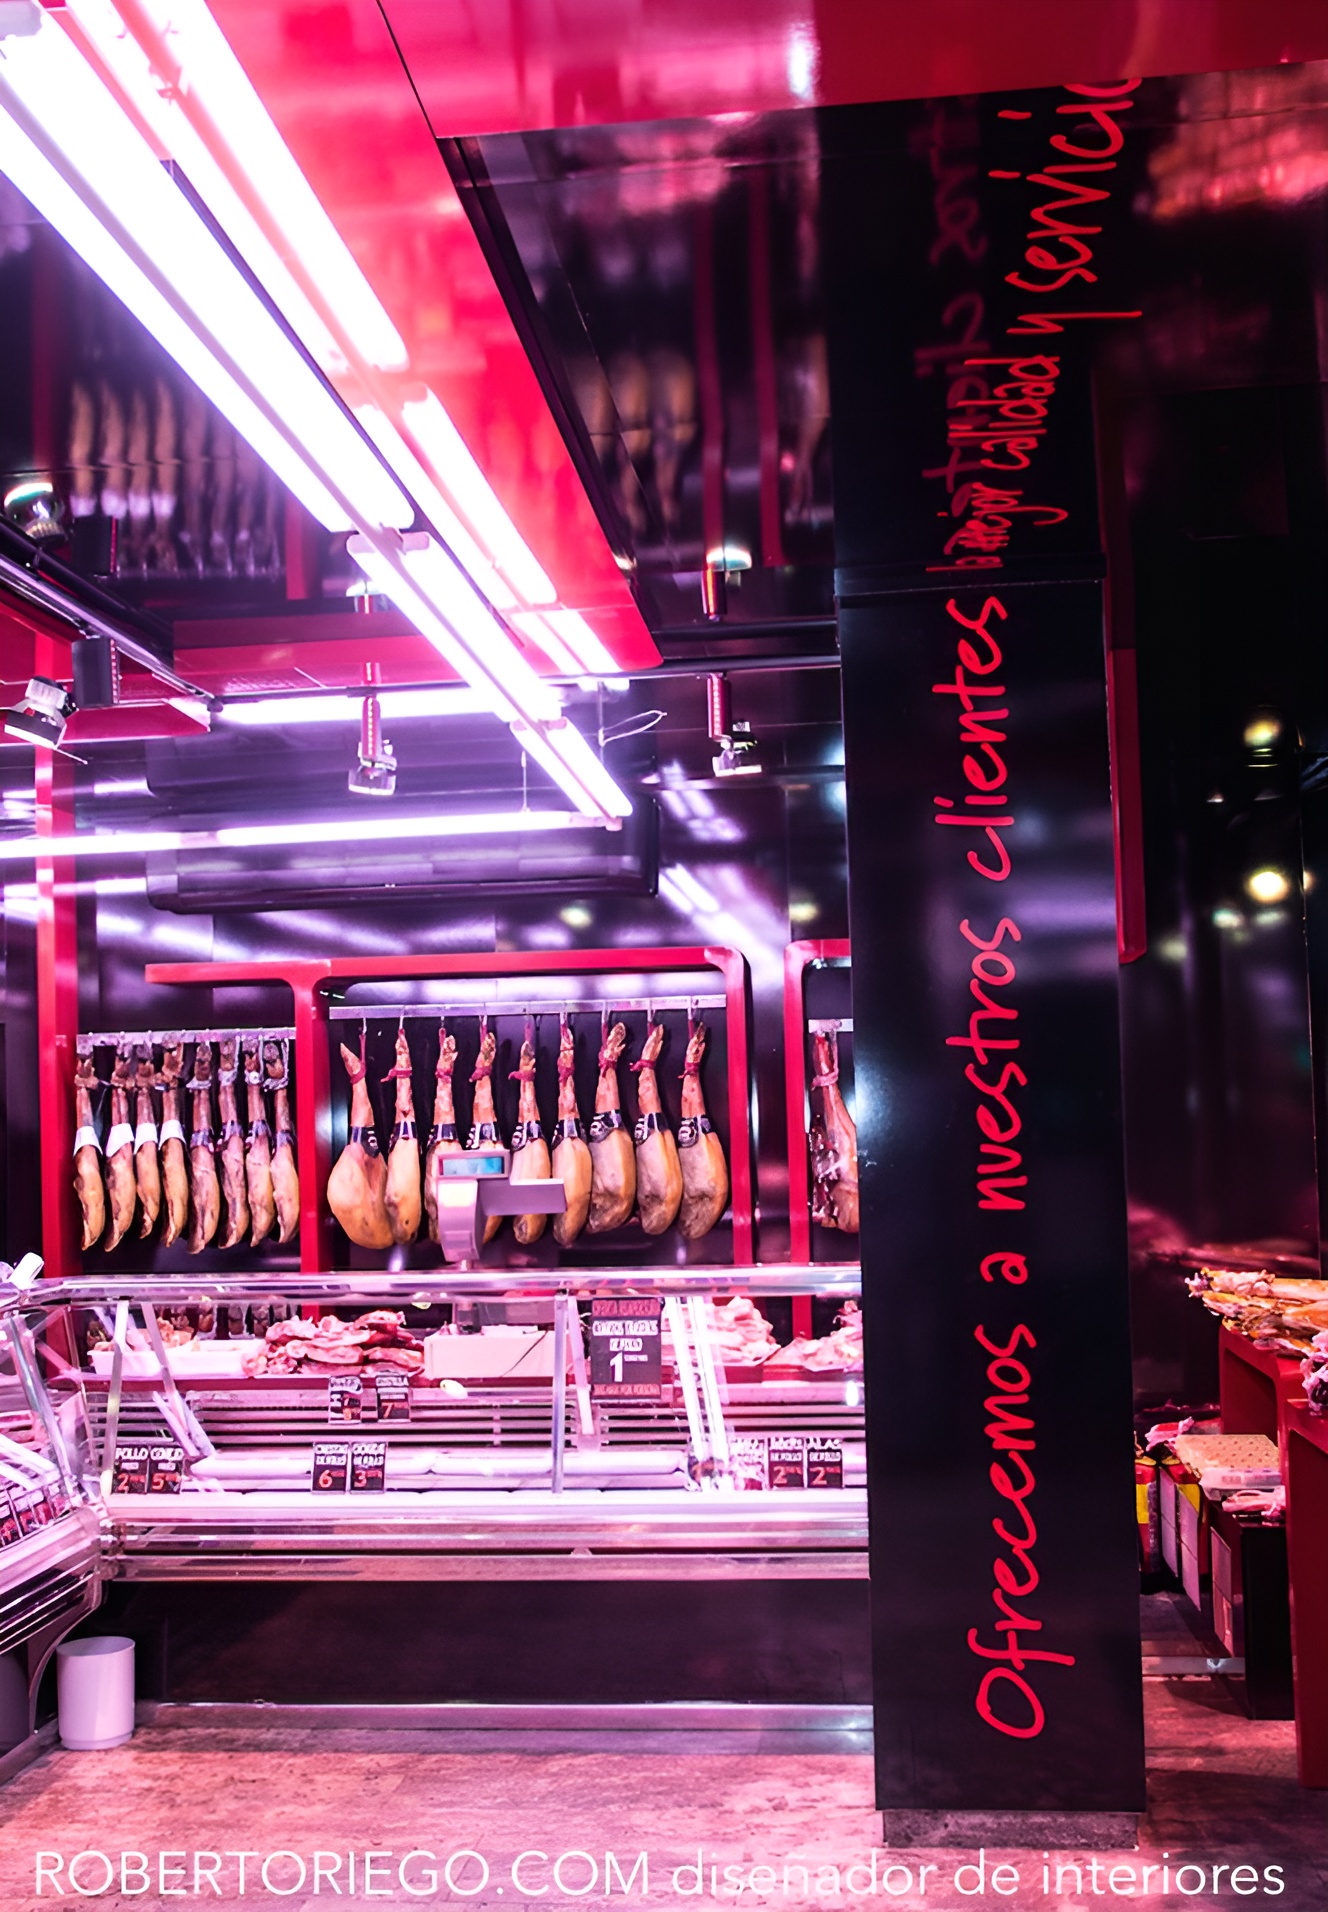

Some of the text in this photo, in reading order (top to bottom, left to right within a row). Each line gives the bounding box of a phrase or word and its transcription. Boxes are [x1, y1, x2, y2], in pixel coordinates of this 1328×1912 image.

[948, 355, 1061, 470] calidad
[1006, 311, 1142, 333] y
[932, 596, 1014, 884] clientes
[945, 918, 1030, 1211] nuestros
[980, 1252, 1029, 1285] a
[967, 1323, 1075, 1740] Ofrecemos
